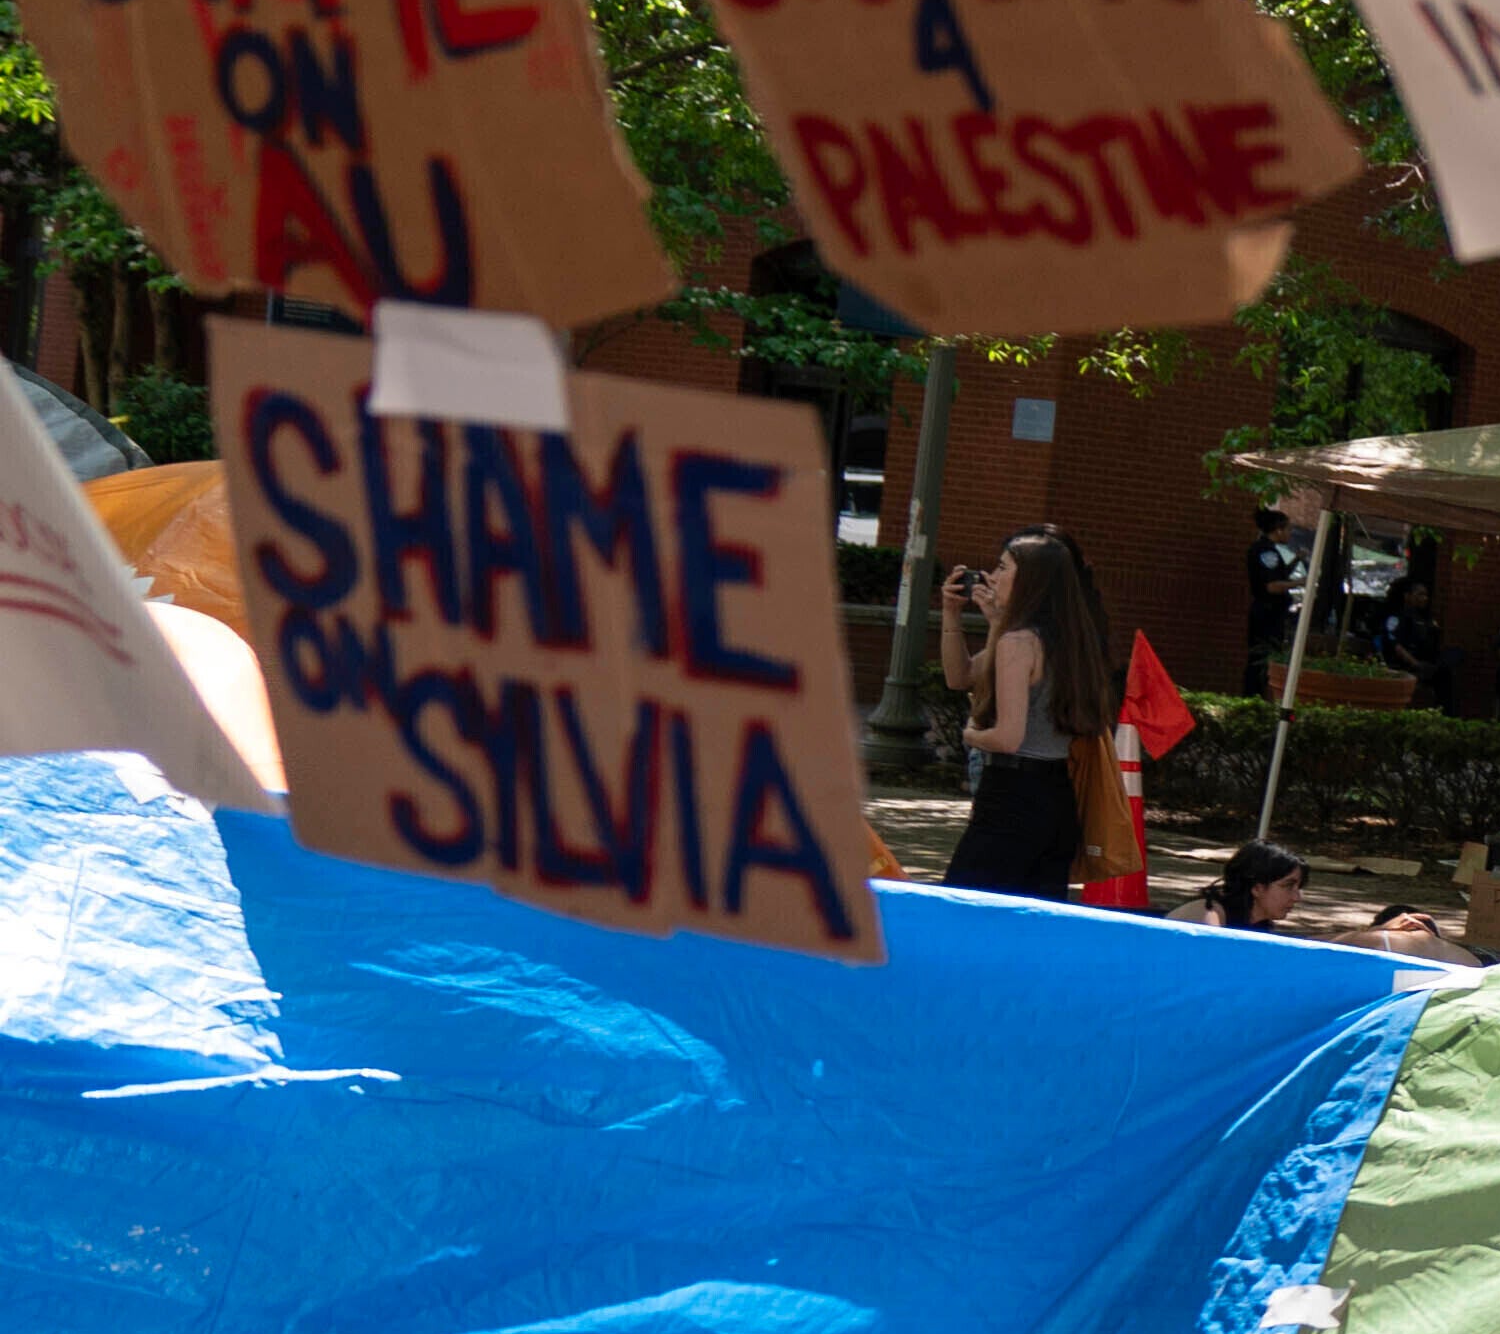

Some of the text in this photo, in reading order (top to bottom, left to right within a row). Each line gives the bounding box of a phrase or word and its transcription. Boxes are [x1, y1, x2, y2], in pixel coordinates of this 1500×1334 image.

[216, 26, 365, 155] ON
[256, 147, 476, 309] AU
[791, 99, 1303, 259] PALESTINE
[243, 384, 806, 693] SHAME
[279, 603, 398, 715] ON
[388, 665, 860, 946] SYLVIA
